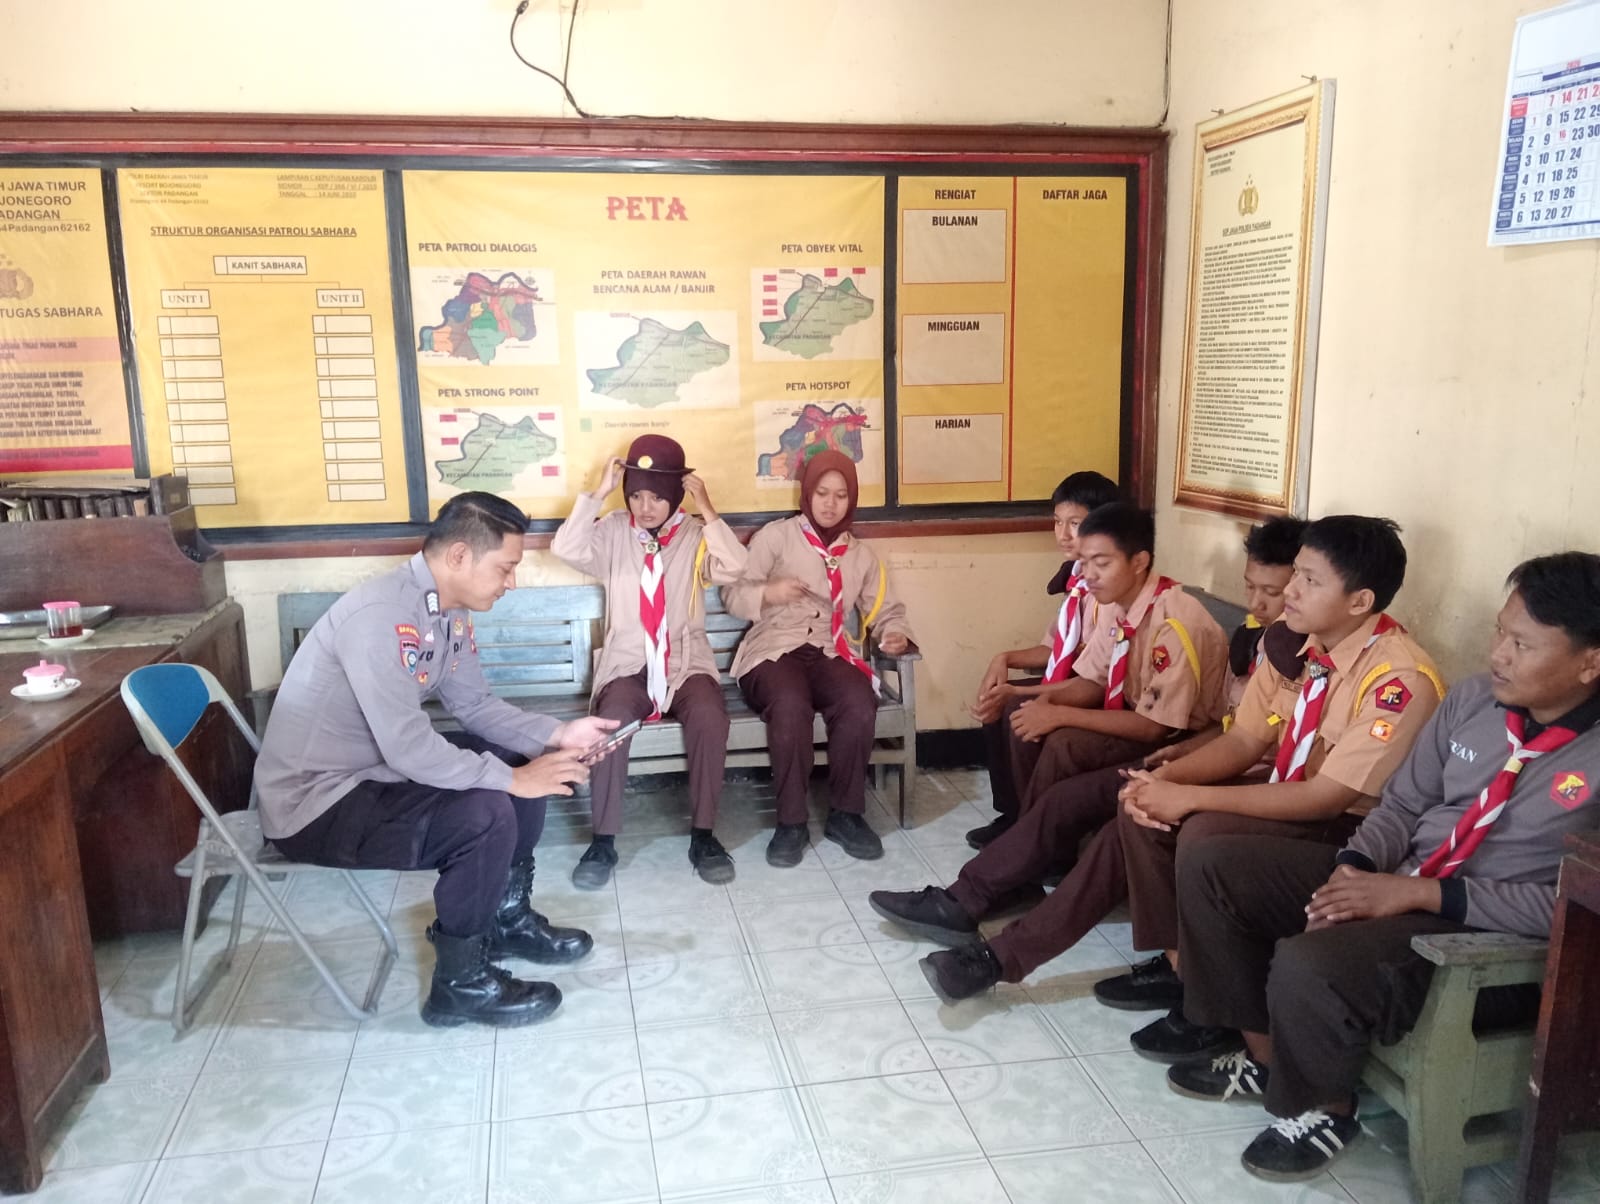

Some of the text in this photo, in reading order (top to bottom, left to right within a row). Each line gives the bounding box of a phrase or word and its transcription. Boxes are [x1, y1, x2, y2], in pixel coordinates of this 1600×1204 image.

[1550, 94, 1555, 106] 7
[1562, 91, 1572, 104] 14
[1577, 87, 1588, 101] 21
[1546, 114, 1552, 126] 8
[1560, 111, 1570, 123] 15
[1573, 107, 1586, 121] 22
[1528, 136, 1535, 148] 2
[1544, 133, 1550, 145] 9
[1572, 127, 1584, 141] 23
[1588, 124, 1600, 138] 30
[1525, 154, 1531, 167] 3
[1539, 152, 1549, 165] 10
[1555, 150, 1565, 162] 17
[1569, 147, 1582, 160] 24
[1522, 173, 1528, 185] 4
[1537, 171, 1545, 183] 11
[1552, 168, 1562, 181] 18
[1566, 166, 1578, 180] 25
[8, 182, 43, 191] JAWA
[47, 181, 87, 191] TIMUR
[935, 190, 976, 200] RENGIAT
[1042, 190, 1108, 200] DAFTAR JAGA
[1519, 192, 1526, 204] 5
[1533, 190, 1544, 203] 12
[1549, 188, 1560, 201] 19
[1563, 186, 1575, 199] 26
[606, 196, 689, 221] PETA
[1517, 211, 1523, 223] 6
[1531, 209, 1541, 221] 13
[1545, 207, 1557, 220] 20
[1561, 205, 1572, 218] 27
[932, 216, 978, 226] BULANAN
[150, 226, 357, 237] STRUKTUR ORGANISASI PATROLI SABHARA
[419, 243, 537, 252] PETA PATROLI DIALOGIS
[781, 244, 863, 253] PETA OBYEK VITAL
[231, 262, 304, 270] KANIT SABHARA
[601, 271, 706, 279] PETA DAERAH RAWAN
[593, 285, 640, 294] BENCANA
[643, 285, 671, 293] ALAM
[681, 285, 715, 293] BANJIR
[168, 295, 197, 303] UNIT
[321, 294, 350, 303] UNIT
[0, 306, 104, 318] TUGAS SABHARA
[928, 321, 980, 332] MINGGUAN
[786, 381, 851, 391] PETA HOTSPOT
[438, 388, 540, 398] PETA STRONG POINT
[935, 419, 971, 429] HARIAN
